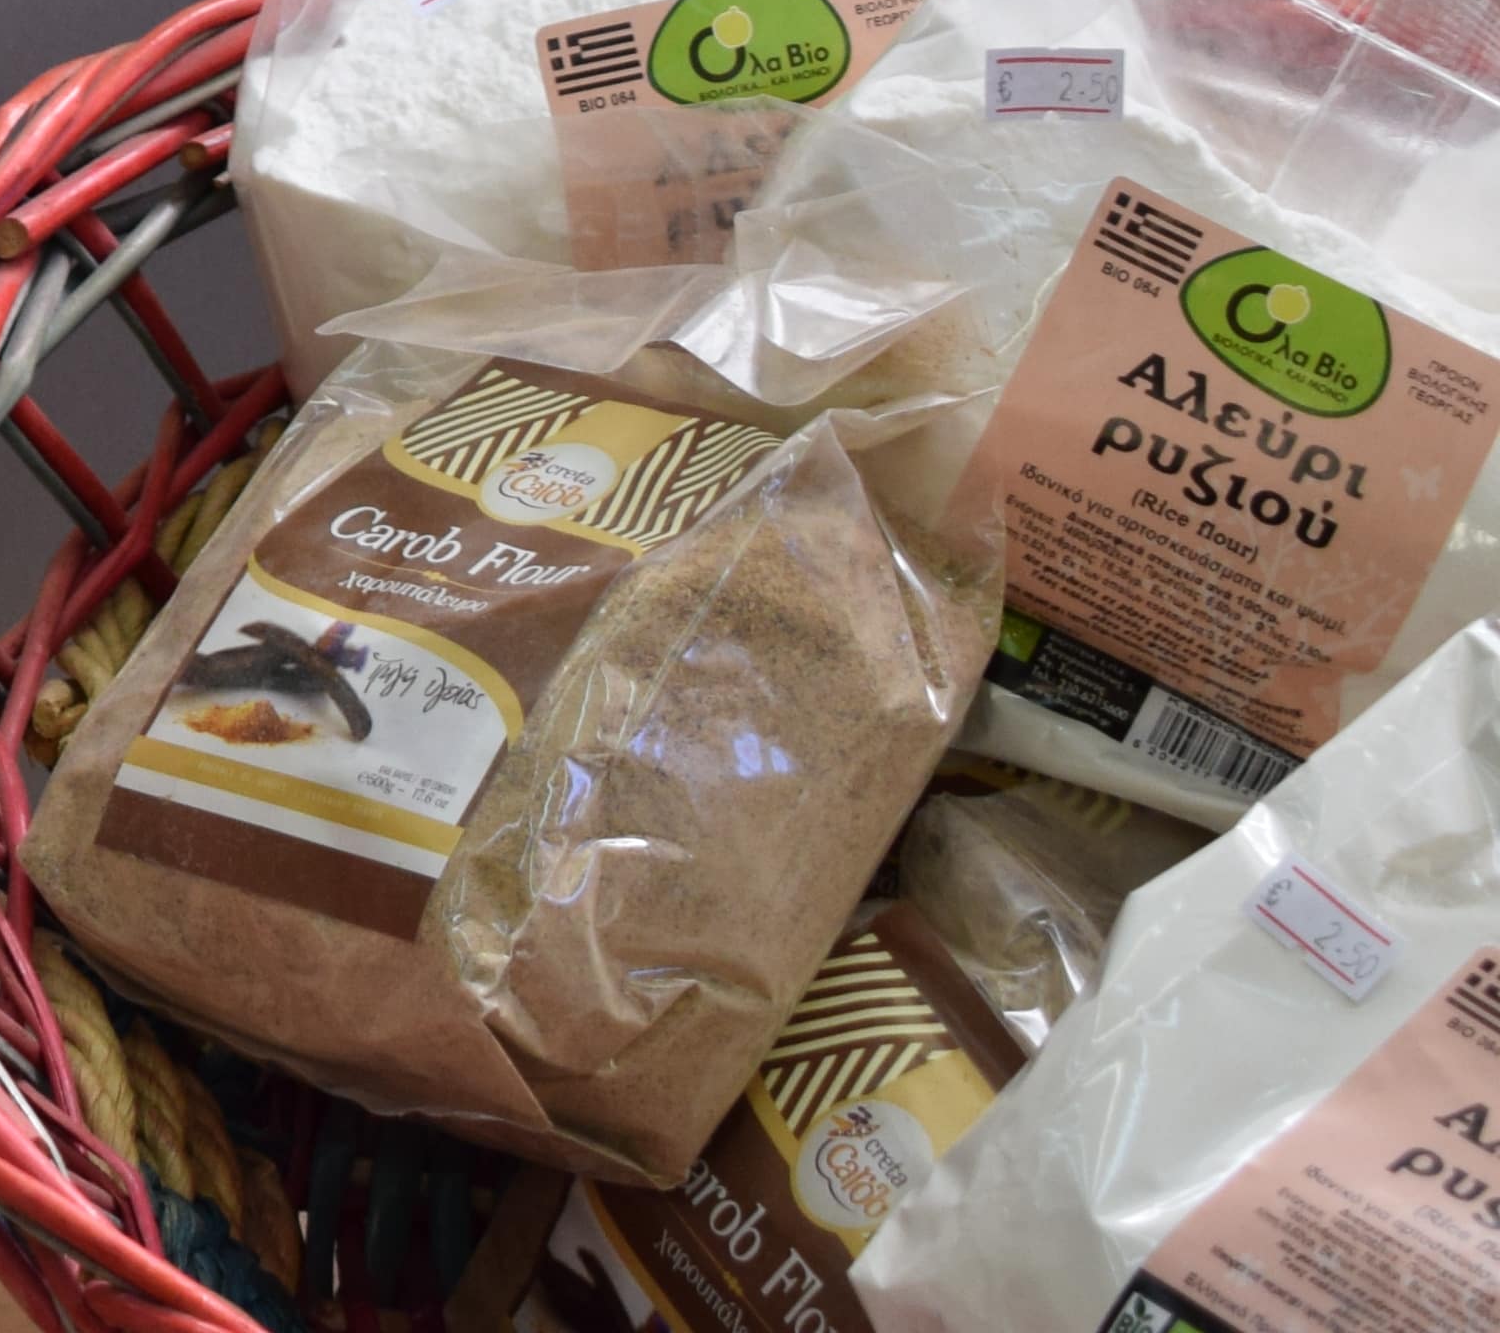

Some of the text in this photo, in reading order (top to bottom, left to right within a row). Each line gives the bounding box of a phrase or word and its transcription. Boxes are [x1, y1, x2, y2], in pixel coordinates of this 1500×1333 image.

[578, 95, 607, 114] BIO
[996, 72, 1118, 102] € 2.50
[1098, 261, 1133, 286] BIO
[1403, 368, 1492, 416] ΒΙΟΛΟΓΙΚΗΣ
[1425, 359, 1485, 394] ΠΡΟΙΟΝ
[1117, 352, 1366, 501] Αλεύρι
[1404, 384, 1476, 425] ΓΕΩΡΓΙΑΣ
[544, 461, 596, 487] creta
[1092, 414, 1340, 549] ρυζιού
[330, 504, 591, 587] Carob Flour
[1015, 462, 1087, 507] Ιδανικό
[1083, 496, 1116, 523] για
[1110, 512, 1269, 596] αρτοσκευάσματα
[1264, 588, 1296, 612] και
[1128, 487, 1263, 565] (Rice flour)
[339, 569, 487, 614] χαρουπάλευρο
[1308, 917, 1386, 982] 2.50
[863, 1134, 910, 1187] creta
[680, 1159, 766, 1267] arob
